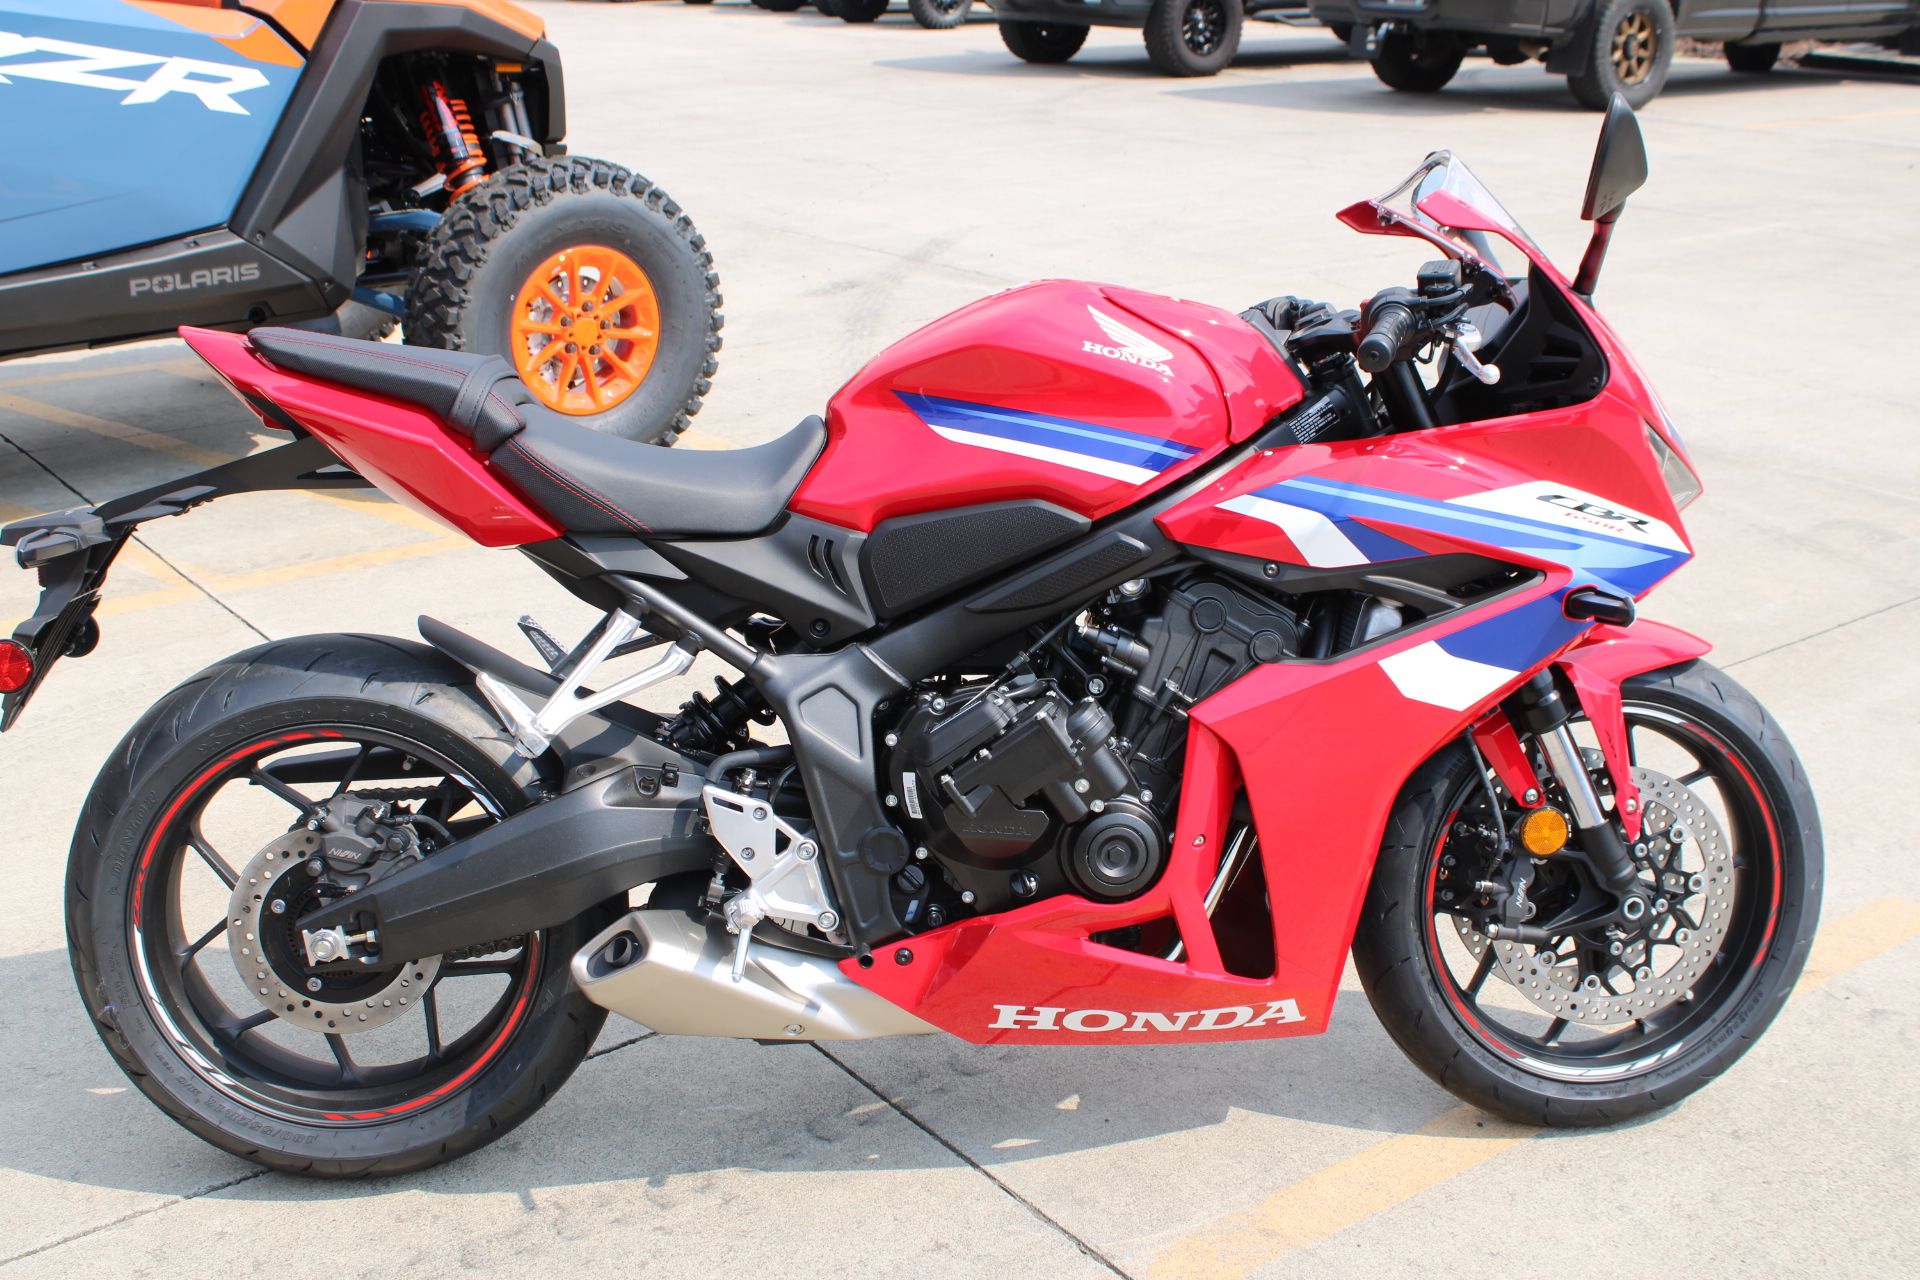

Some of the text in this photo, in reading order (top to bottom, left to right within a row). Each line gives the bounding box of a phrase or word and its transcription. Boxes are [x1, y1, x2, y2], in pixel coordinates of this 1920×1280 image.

[129, 262, 260, 297] POLARIS
[1081, 340, 1175, 377] HONDA
[1536, 494, 1649, 535] CBR
[988, 998, 1306, 1032] HONDA
